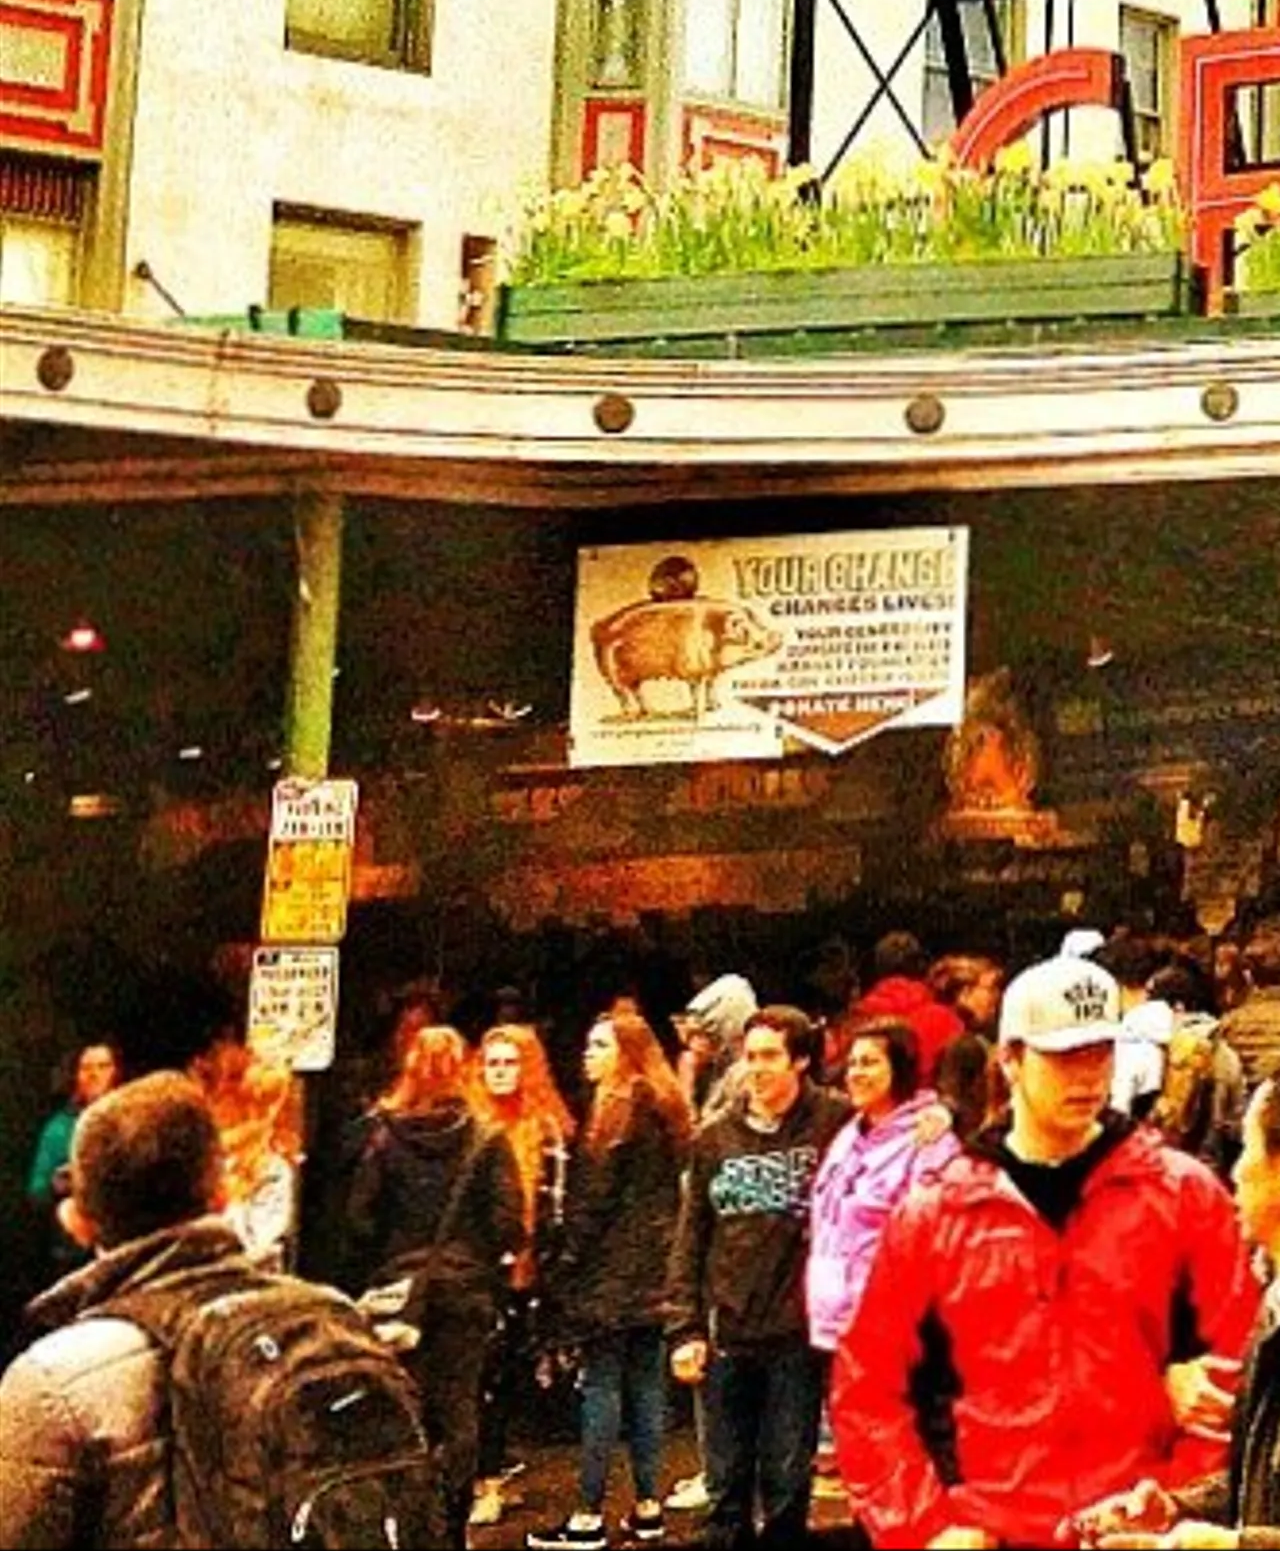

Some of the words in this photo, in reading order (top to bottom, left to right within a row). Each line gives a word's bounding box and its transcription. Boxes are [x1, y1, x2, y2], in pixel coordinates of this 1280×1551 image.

[733, 554, 820, 599] YOUR
[825, 548, 957, 592] CHANGE
[769, 595, 877, 617] CHANGES
